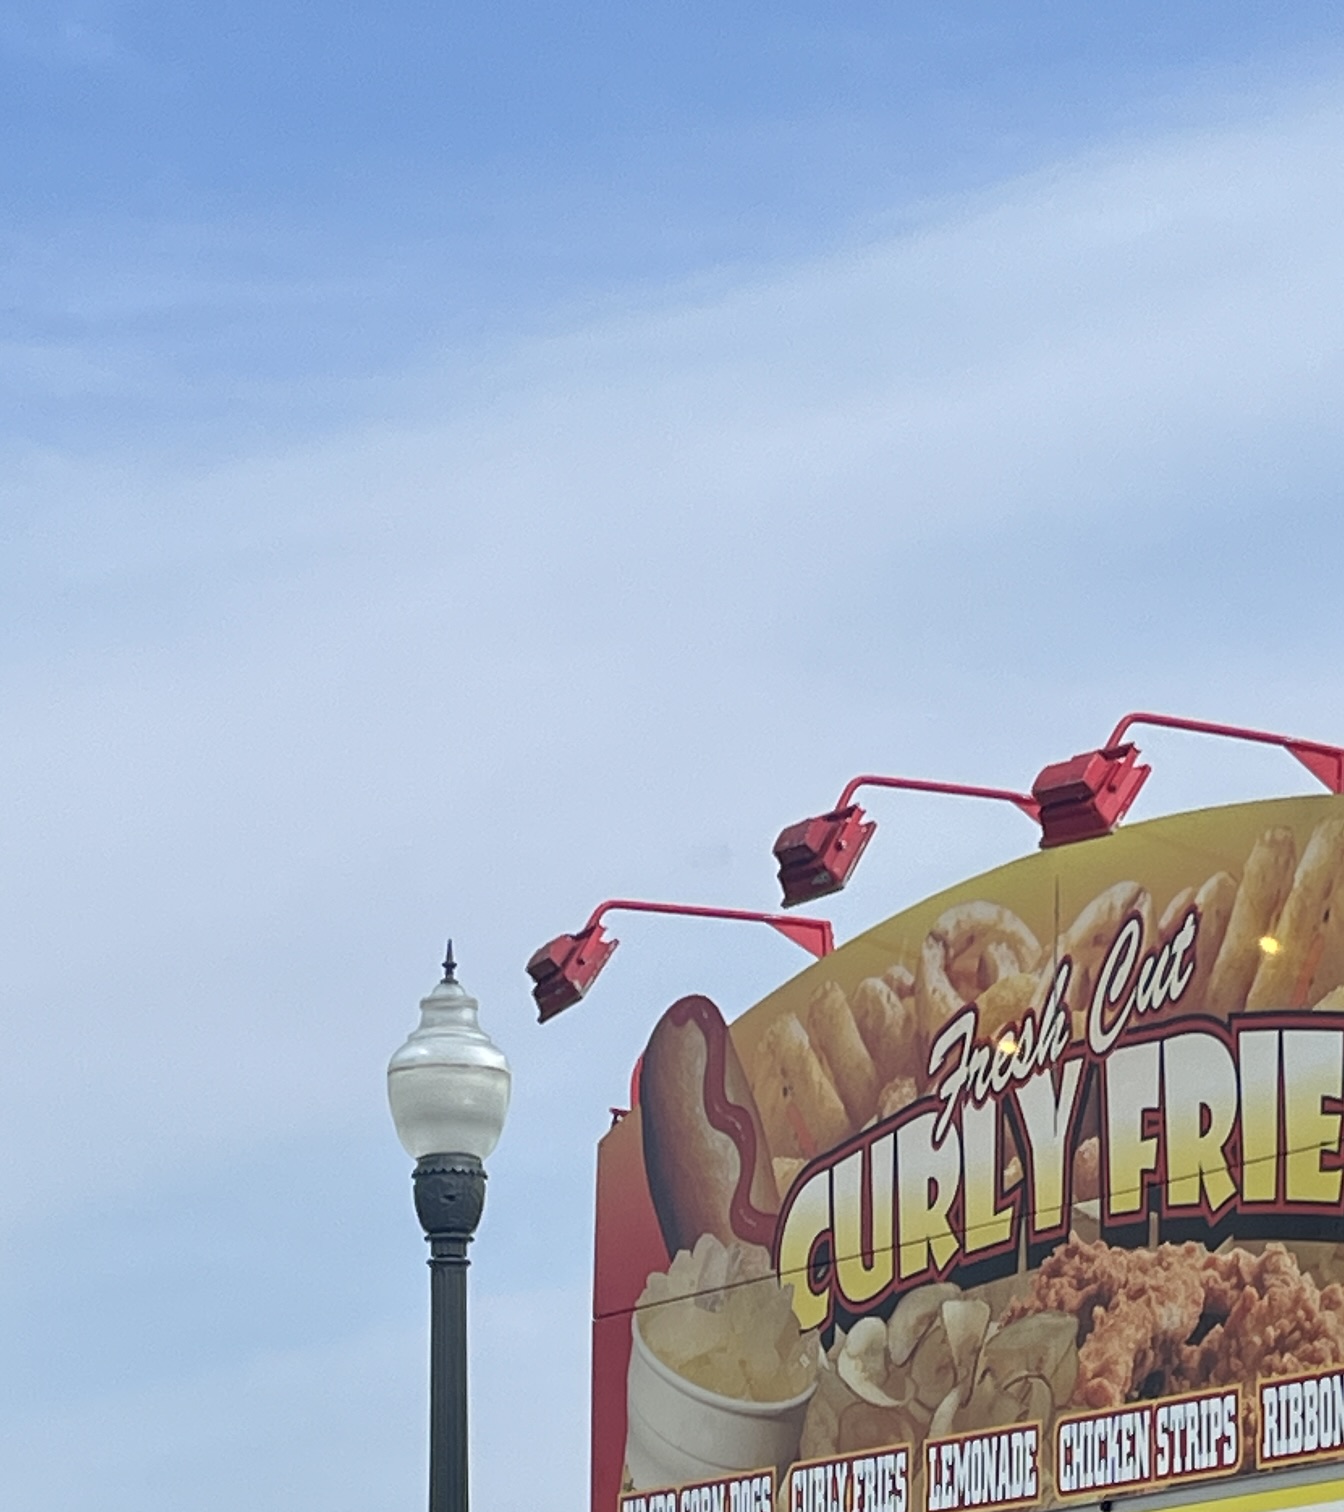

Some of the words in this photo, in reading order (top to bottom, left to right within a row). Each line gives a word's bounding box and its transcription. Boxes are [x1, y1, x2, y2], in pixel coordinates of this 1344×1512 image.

[930, 959, 1070, 1150] Fresh
[1088, 910, 1198, 1054] Cut
[778, 1058, 1085, 1331] CURLY
[927, 1429, 1037, 1512] LEMONADE
[1059, 1409, 1152, 1493] CHICKEN
[1156, 1393, 1237, 1476] STRIPS
